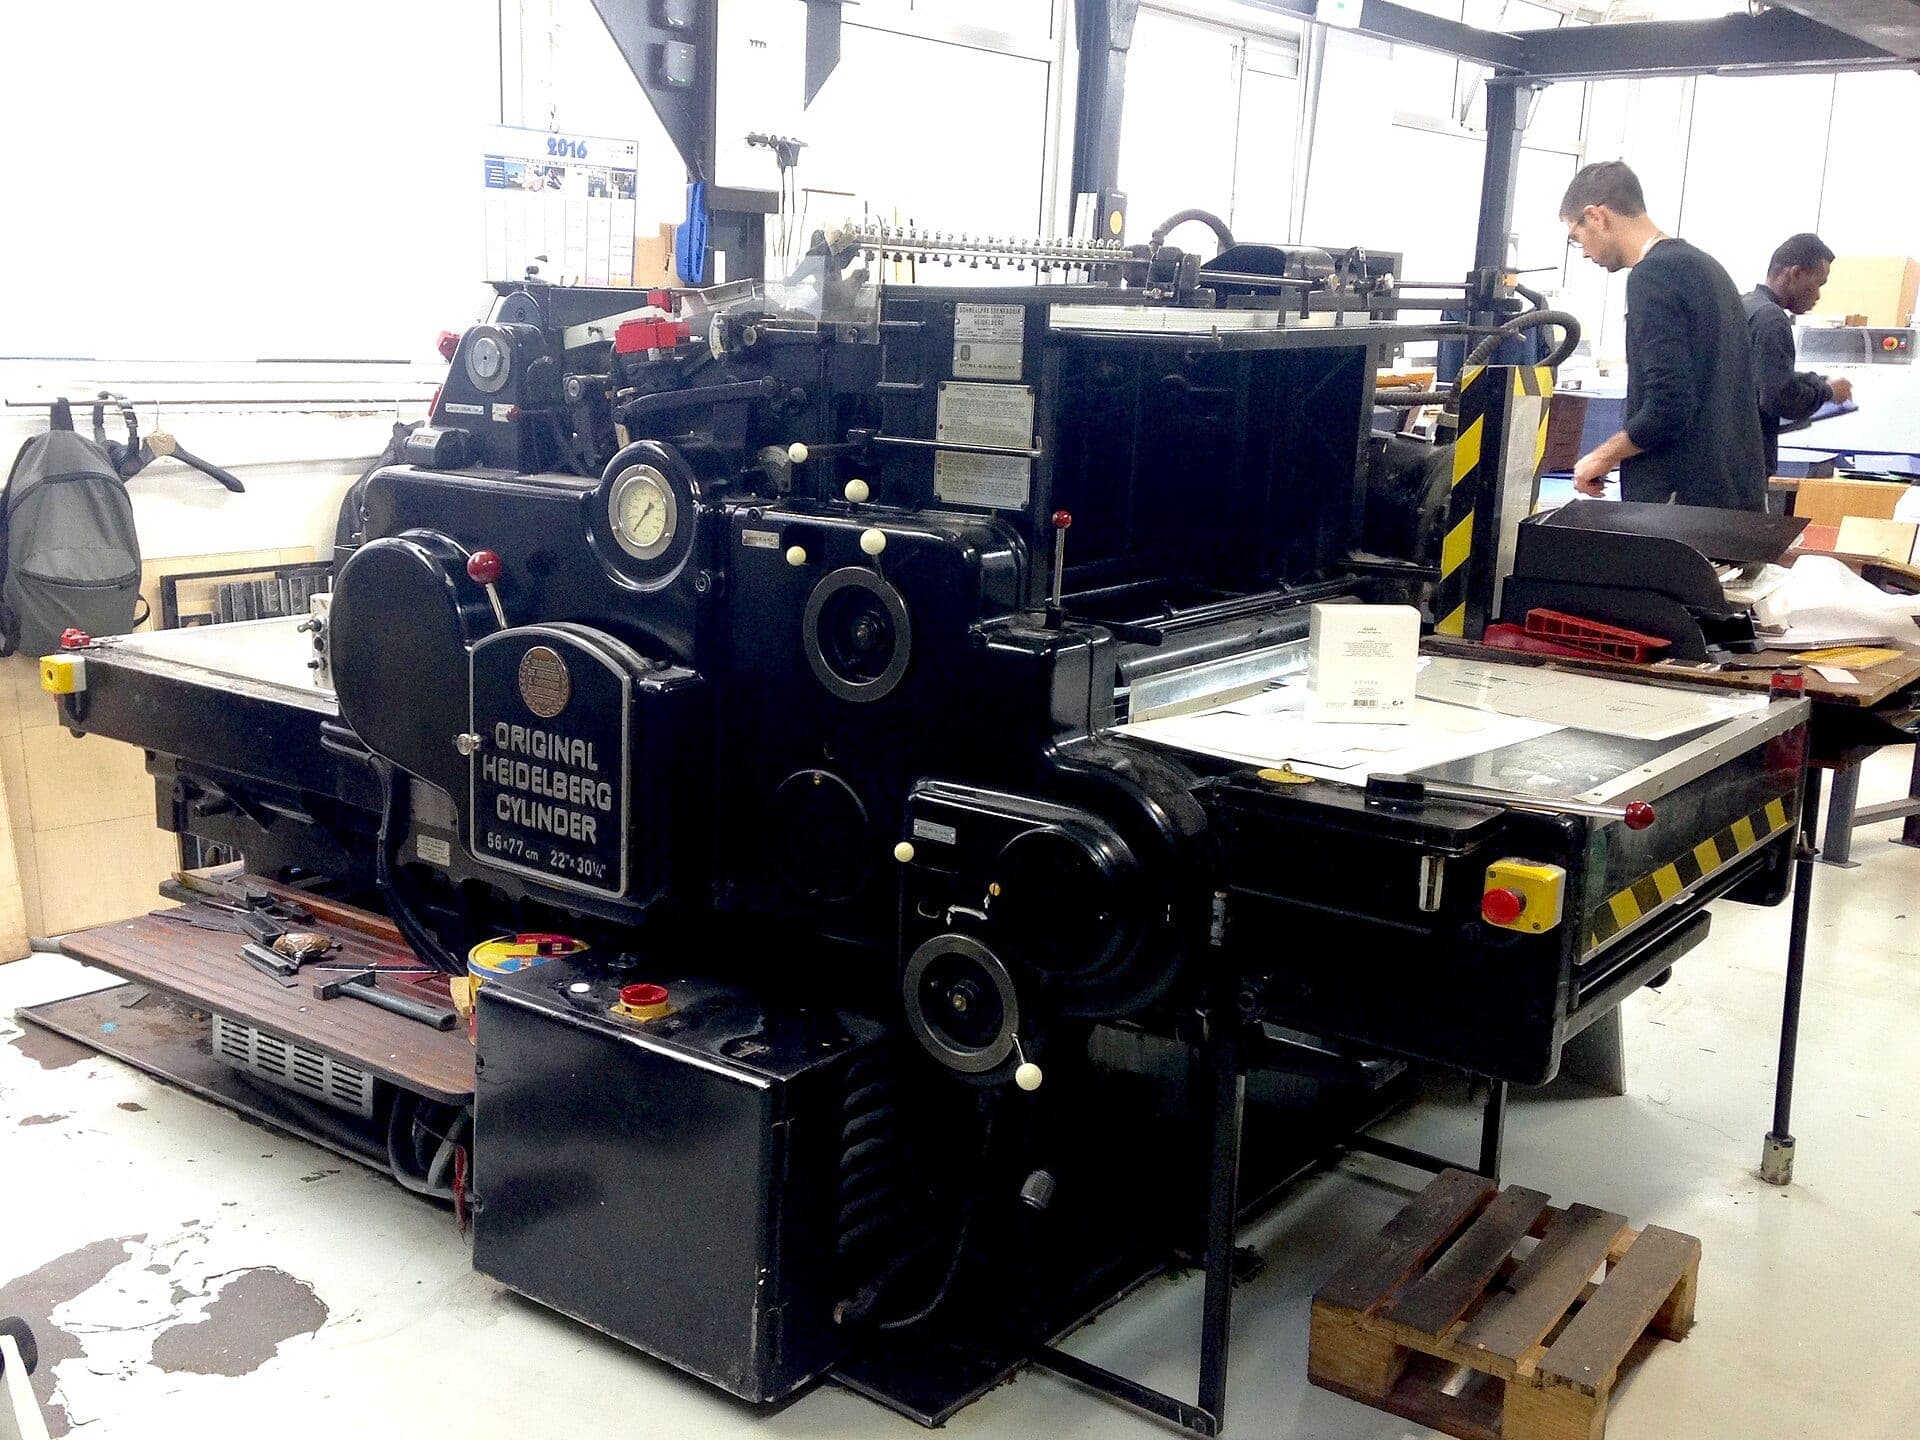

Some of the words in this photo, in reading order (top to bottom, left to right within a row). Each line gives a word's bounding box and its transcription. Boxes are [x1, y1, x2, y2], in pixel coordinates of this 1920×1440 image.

[547, 137, 588, 159] 2016
[495, 722, 598, 771] ORIGINAL
[483, 754, 612, 811] HEIDELBERG
[496, 793, 597, 844] CYLINDER
[525, 849, 539, 862] cm
